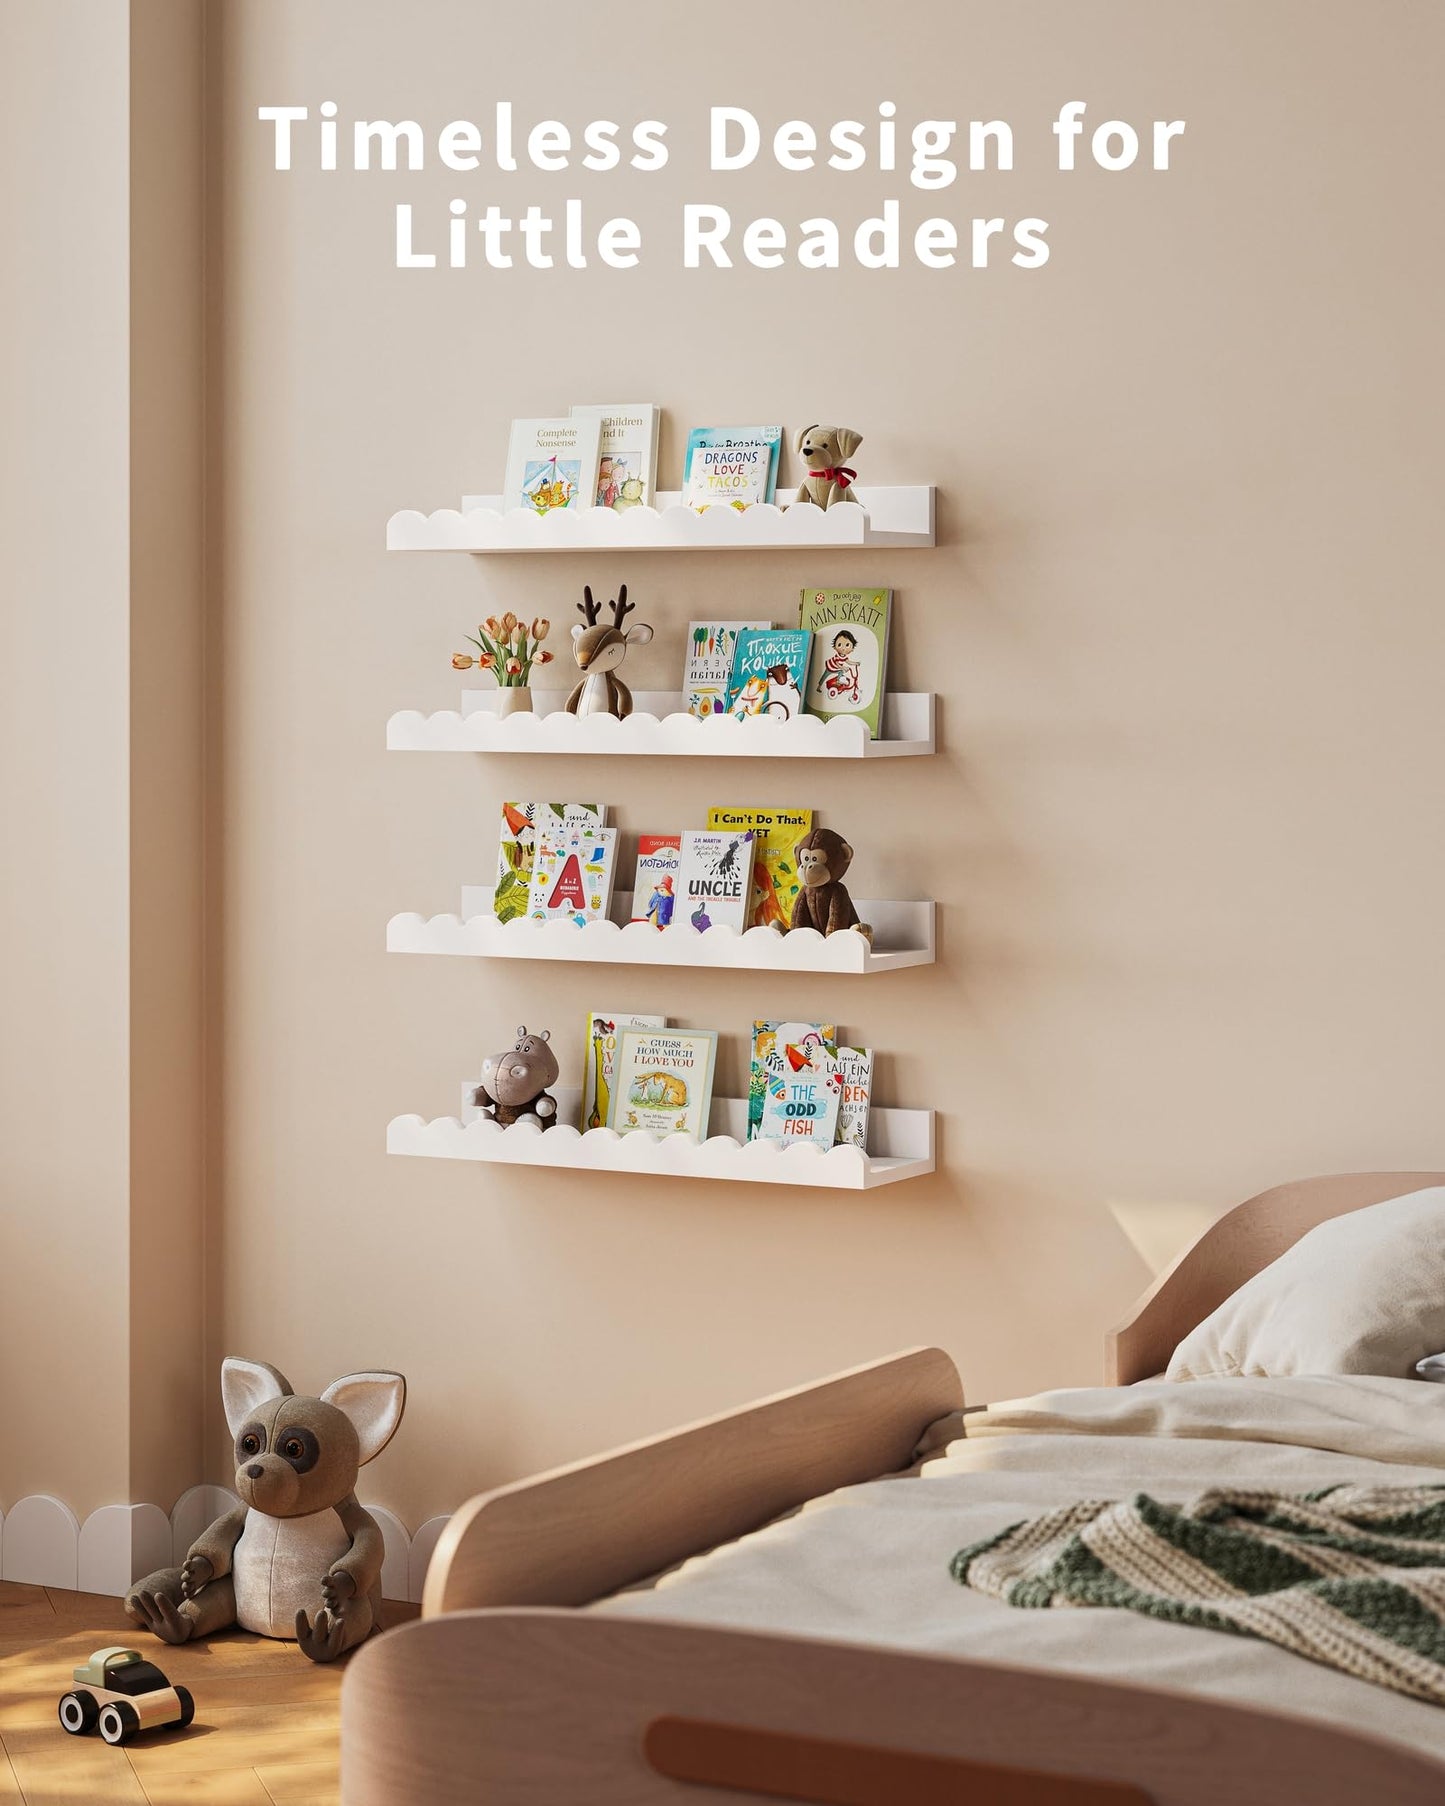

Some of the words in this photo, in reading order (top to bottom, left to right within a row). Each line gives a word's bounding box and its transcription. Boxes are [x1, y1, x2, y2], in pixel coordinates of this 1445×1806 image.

[601, 417, 643, 427] Children
[537, 428, 578, 439] Complete
[602, 428, 616, 438] nd
[536, 439, 577, 448] Nonsense
[704, 451, 759, 465] DRAGONS
[714, 464, 745, 476] LOVE
[707, 475, 749, 489] TACOS
[810, 605, 837, 631] MIN
[840, 602, 883, 628] SKATT
[714, 814, 719, 823] I
[722, 813, 752, 824] Can't
[756, 814, 773, 824] Do
[776, 815, 806, 826] That,
[688, 879, 743, 897] UNCLE
[650, 1039, 681, 1049] GUESS
[636, 1046, 661, 1056] HOW
[663, 1048, 693, 1058] MUCH
[634, 1055, 638, 1064] I
[641, 1056, 669, 1066] LOVE
[671, 1057, 694, 1068] YOU
[791, 1085, 817, 1101] THE
[785, 1103, 817, 1117] ODD
[783, 1119, 814, 1136] FISH
